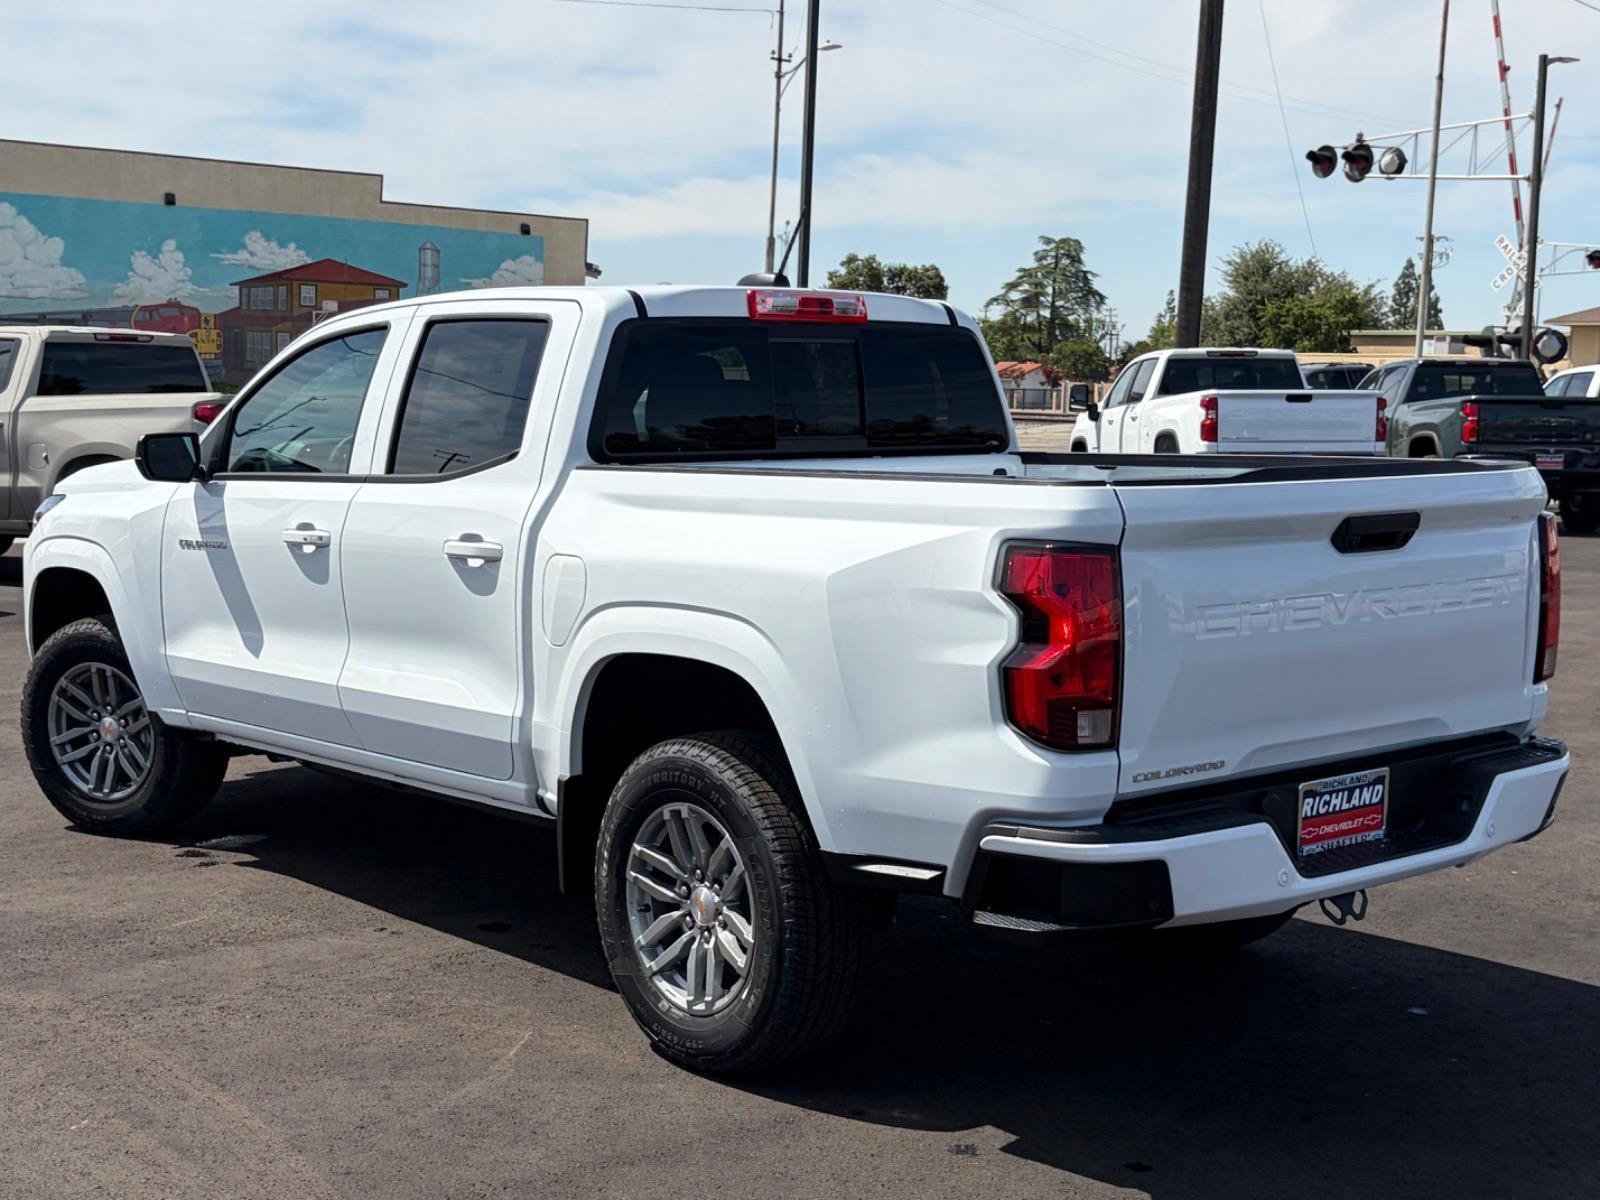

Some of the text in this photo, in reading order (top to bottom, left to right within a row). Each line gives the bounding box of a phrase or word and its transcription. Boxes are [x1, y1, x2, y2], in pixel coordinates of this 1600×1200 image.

[1493, 236, 1544, 289] CROSSG
[1195, 573, 1520, 639] CHEVROLET
[1132, 760, 1225, 783] COLORADO
[1321, 774, 1369, 790] RICHLAND
[1302, 784, 1383, 817] RICHLAND
[1320, 818, 1363, 834] CHEVROLET
